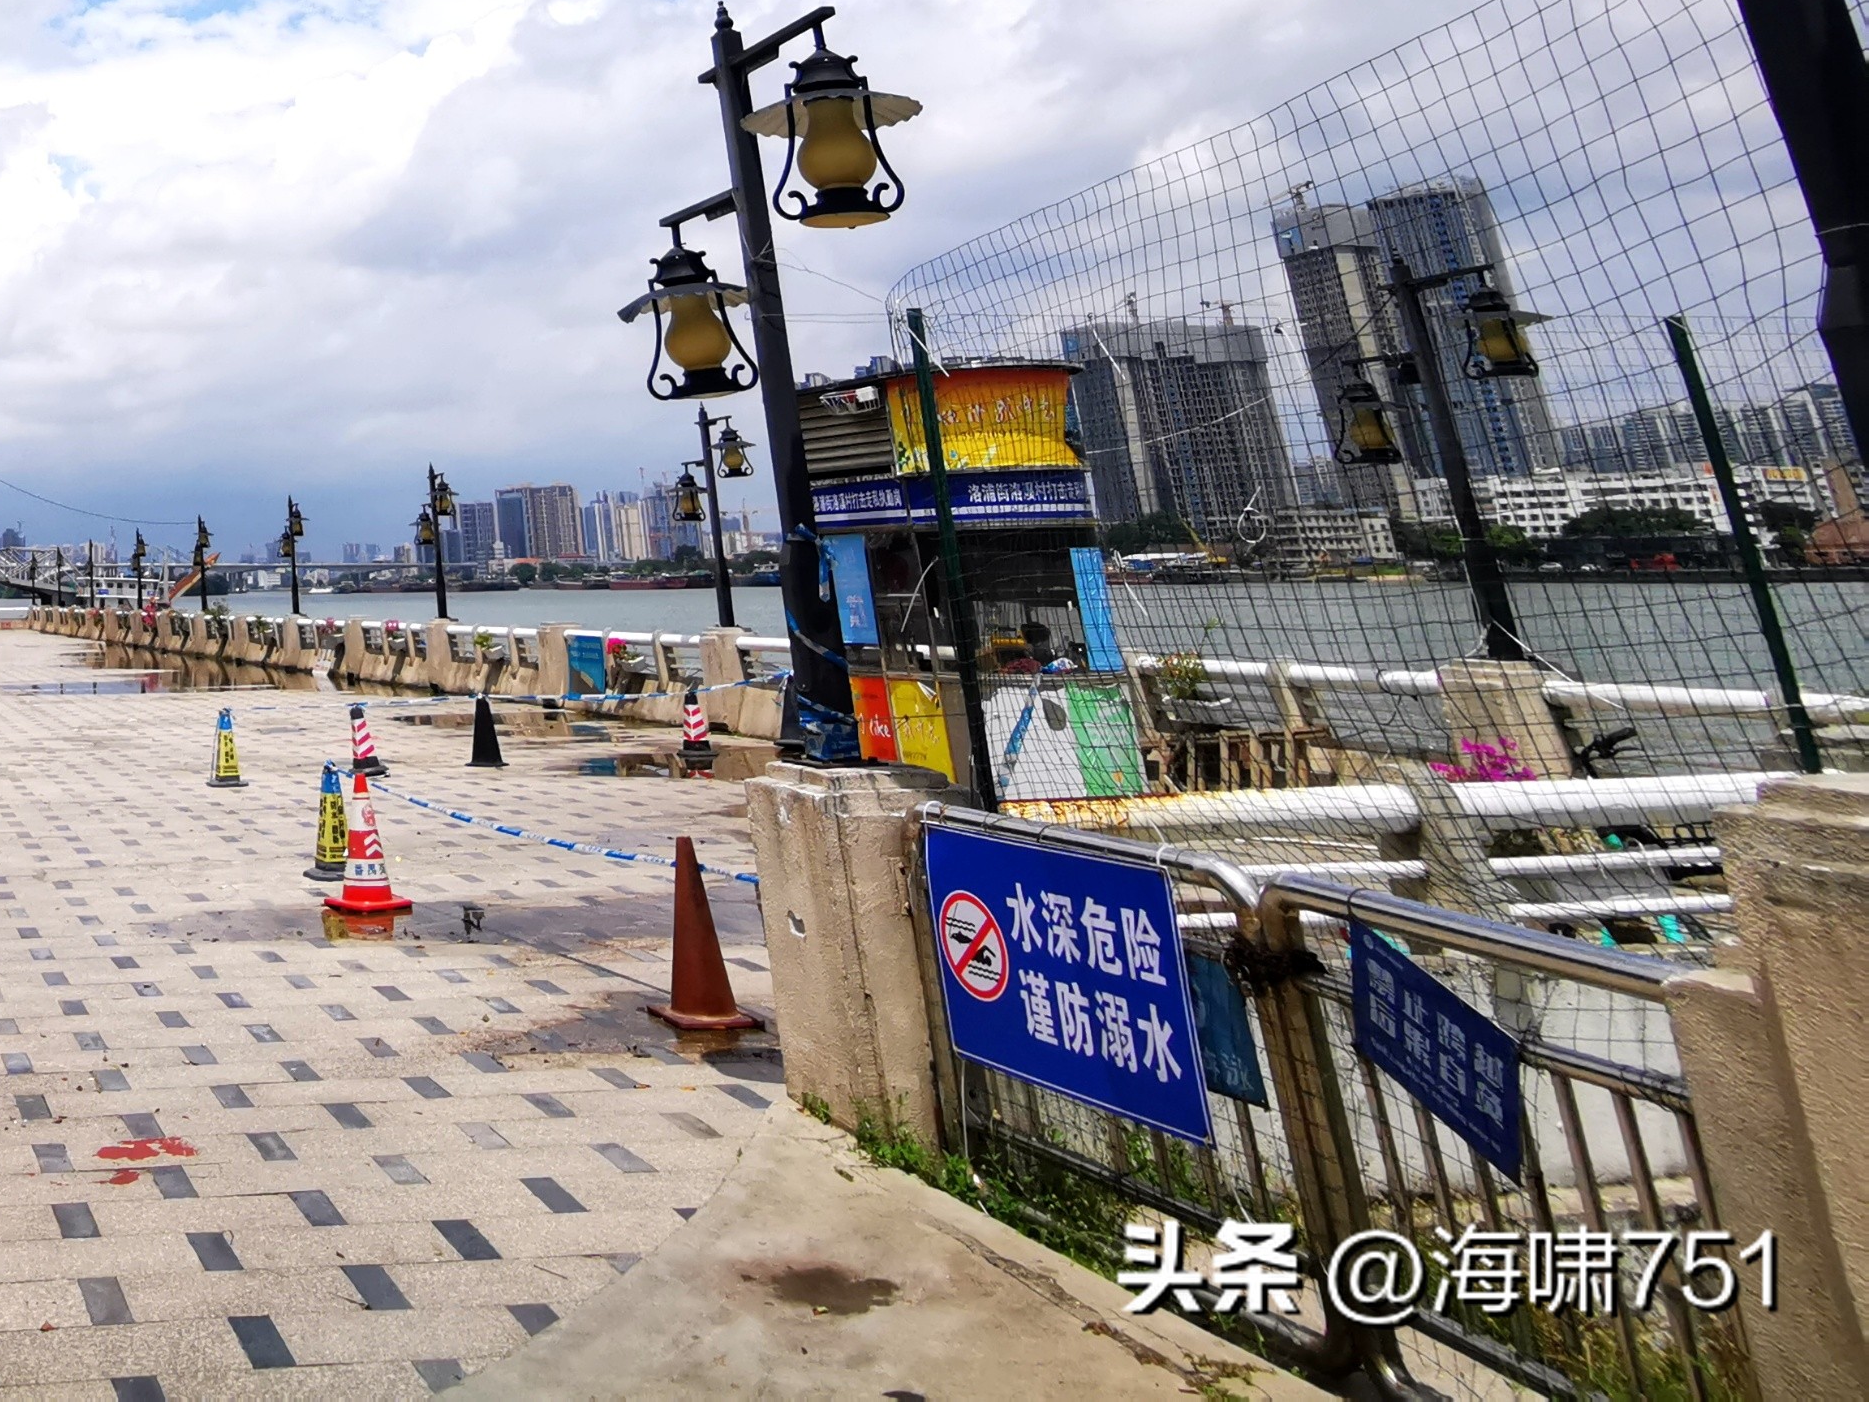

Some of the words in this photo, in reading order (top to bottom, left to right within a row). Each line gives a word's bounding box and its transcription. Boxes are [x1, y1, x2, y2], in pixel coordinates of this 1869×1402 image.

[869, 713, 892, 738] like
[1005, 882, 1168, 987] 水深危险
[1018, 968, 1183, 1084] 谨防溺水
[1365, 957, 1505, 1095] 禁止跨越
[1368, 990, 1505, 1131] 后果自负
